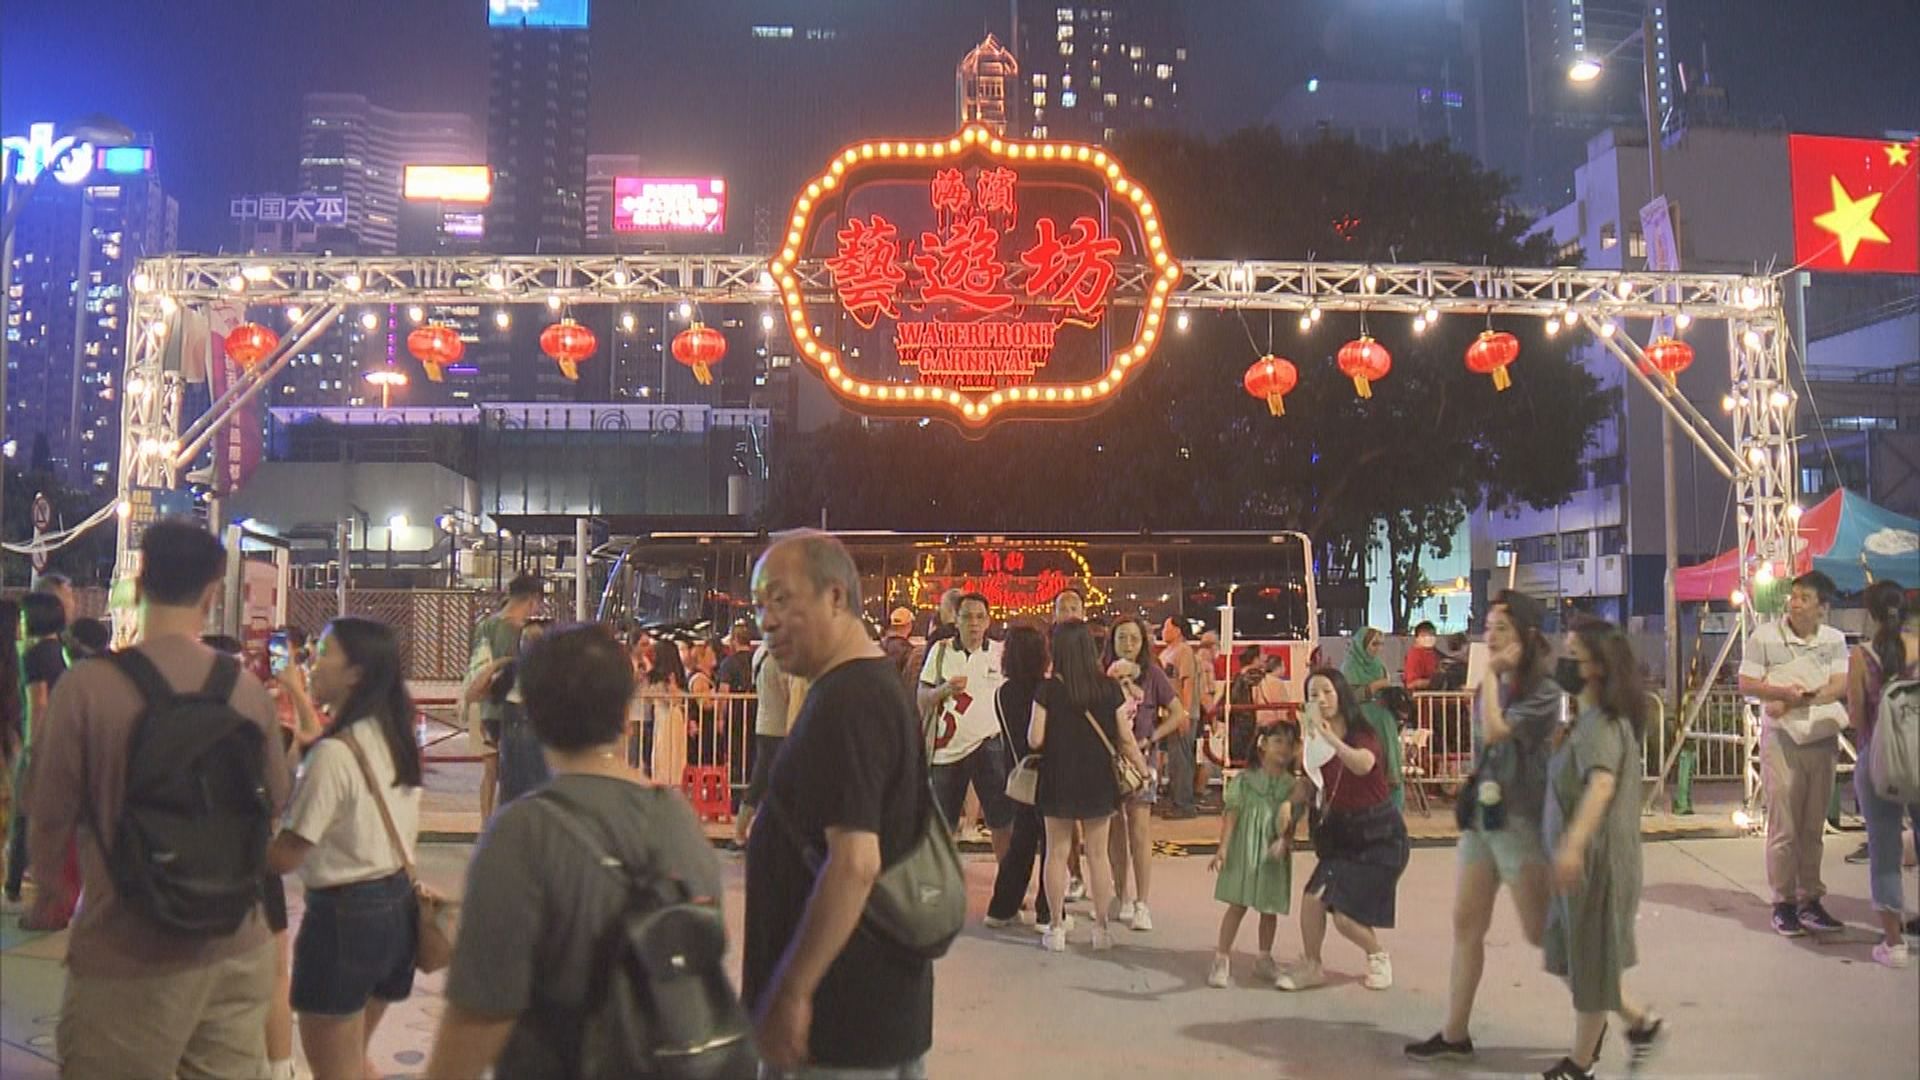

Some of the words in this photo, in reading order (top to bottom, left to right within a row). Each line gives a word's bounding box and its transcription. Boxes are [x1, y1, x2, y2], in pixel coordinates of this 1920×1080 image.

[931, 168, 1018, 212] 海濱
[230, 197, 343, 221] 中国太平
[826, 215, 1121, 318] 藝遊坊
[897, 322, 1056, 348] WATERFRONT
[918, 349, 1034, 375] CARNIVAL
